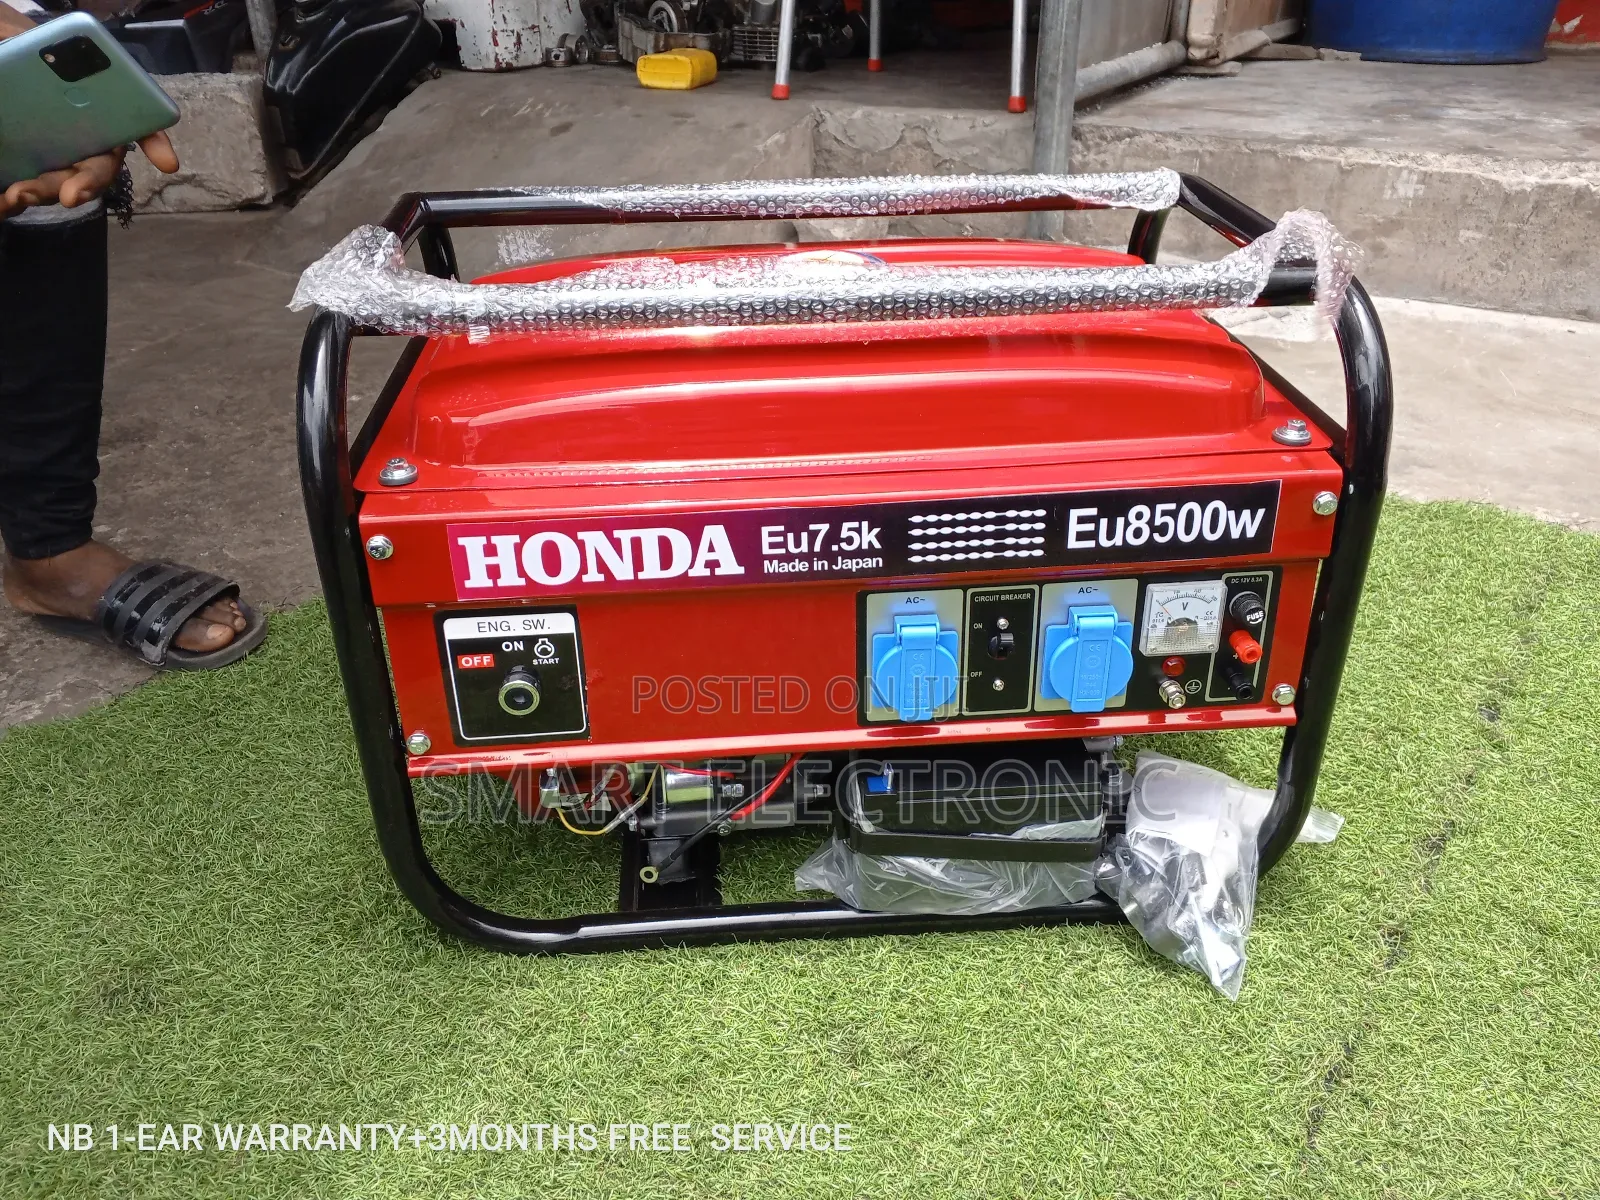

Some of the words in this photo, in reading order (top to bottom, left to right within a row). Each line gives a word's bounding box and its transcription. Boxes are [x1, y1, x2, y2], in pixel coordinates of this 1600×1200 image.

[1066, 500, 1266, 549] Eu8500w
[761, 521, 882, 555] Eu7.5k
[458, 525, 745, 588] HONDA
[763, 557, 809, 574] Made
[813, 557, 829, 572] in
[832, 555, 883, 574] Japan
[974, 595, 999, 603] CIRCUIT
[1001, 592, 1031, 602] BREAKER
[1182, 602, 1189, 611] V
[1246, 610, 1264, 621] FUSE
[477, 620, 516, 633] ENG.
[521, 617, 551, 632] SW.
[502, 641, 524, 652] ON
[461, 656, 492, 668] OFF
[532, 657, 560, 665] START
[970, 670, 983, 678] OFF
